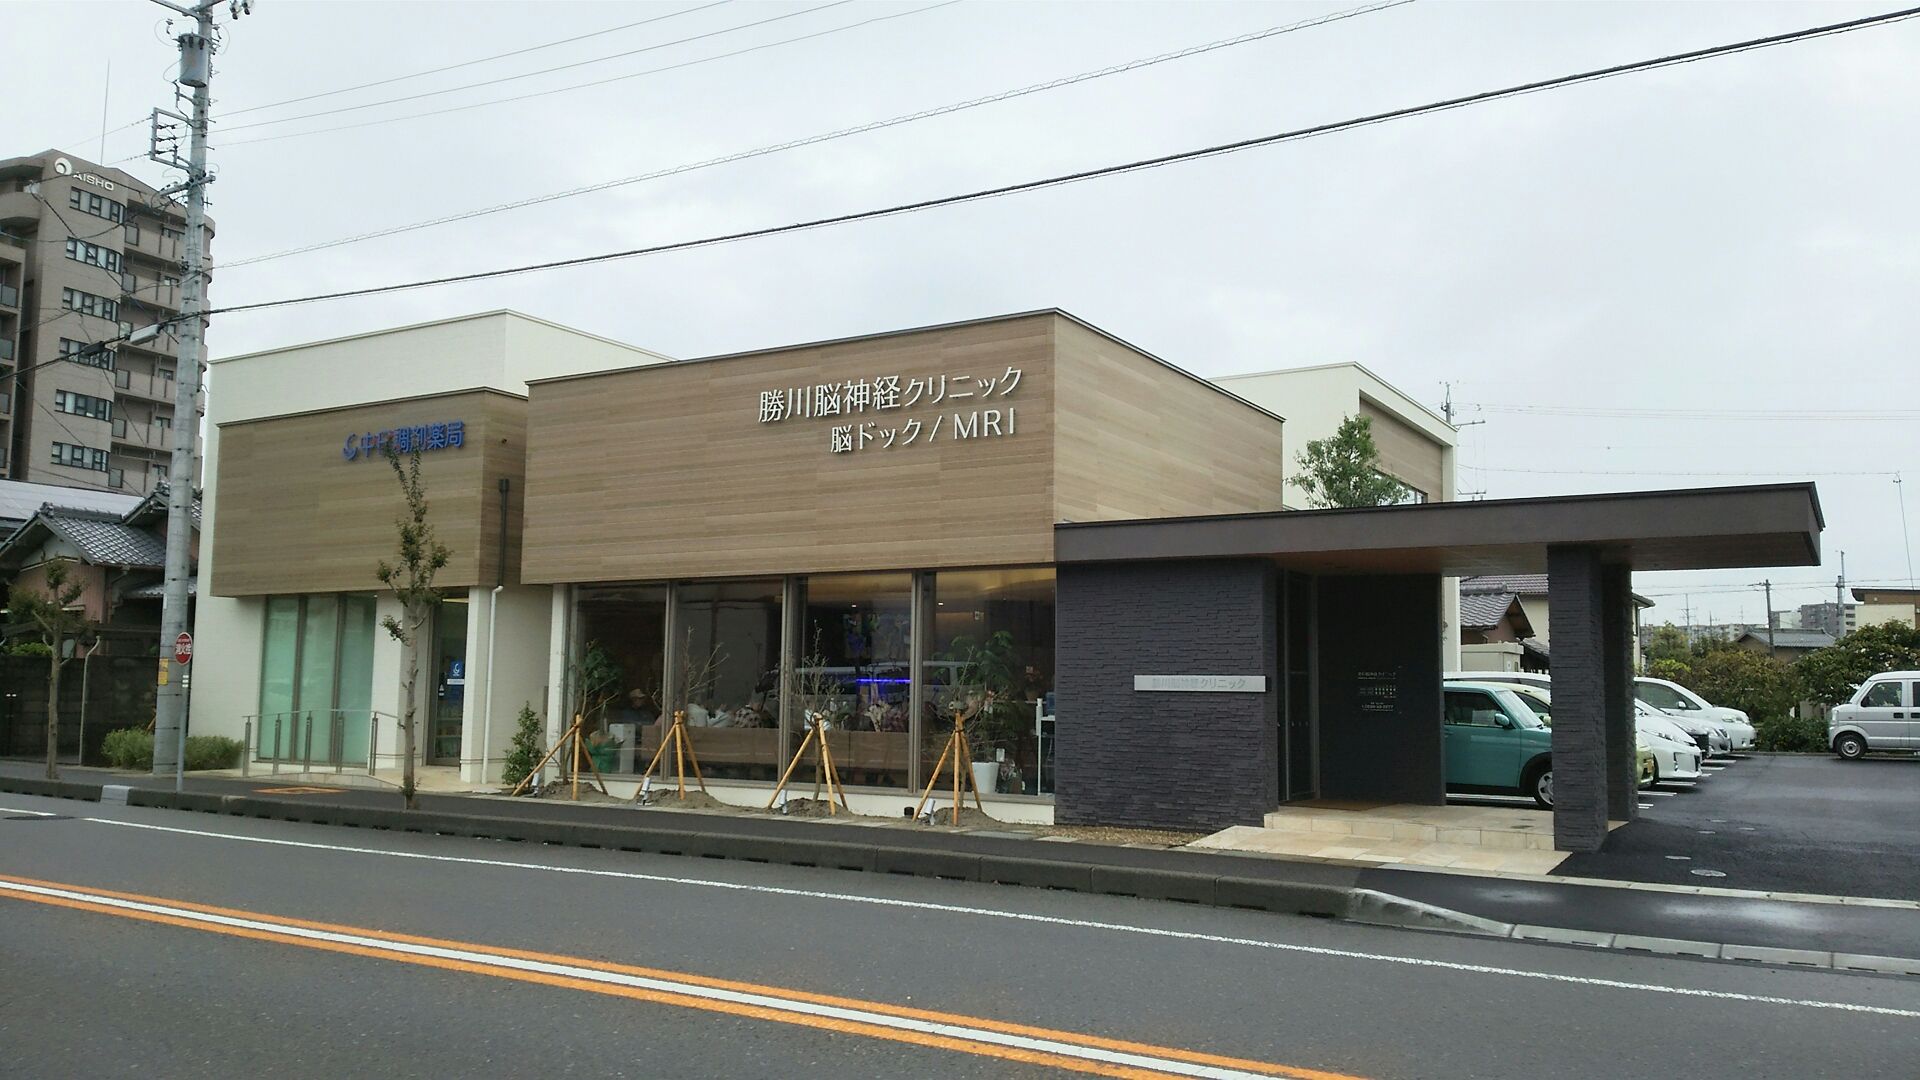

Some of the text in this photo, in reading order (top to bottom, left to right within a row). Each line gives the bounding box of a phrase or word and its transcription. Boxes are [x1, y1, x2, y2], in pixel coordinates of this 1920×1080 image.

[72, 171, 114, 191] AISHO
[758, 366, 1023, 423] 勝川脳神経クリニック
[830, 417, 923, 454] 脳ドック
[953, 407, 1016, 440] MRI
